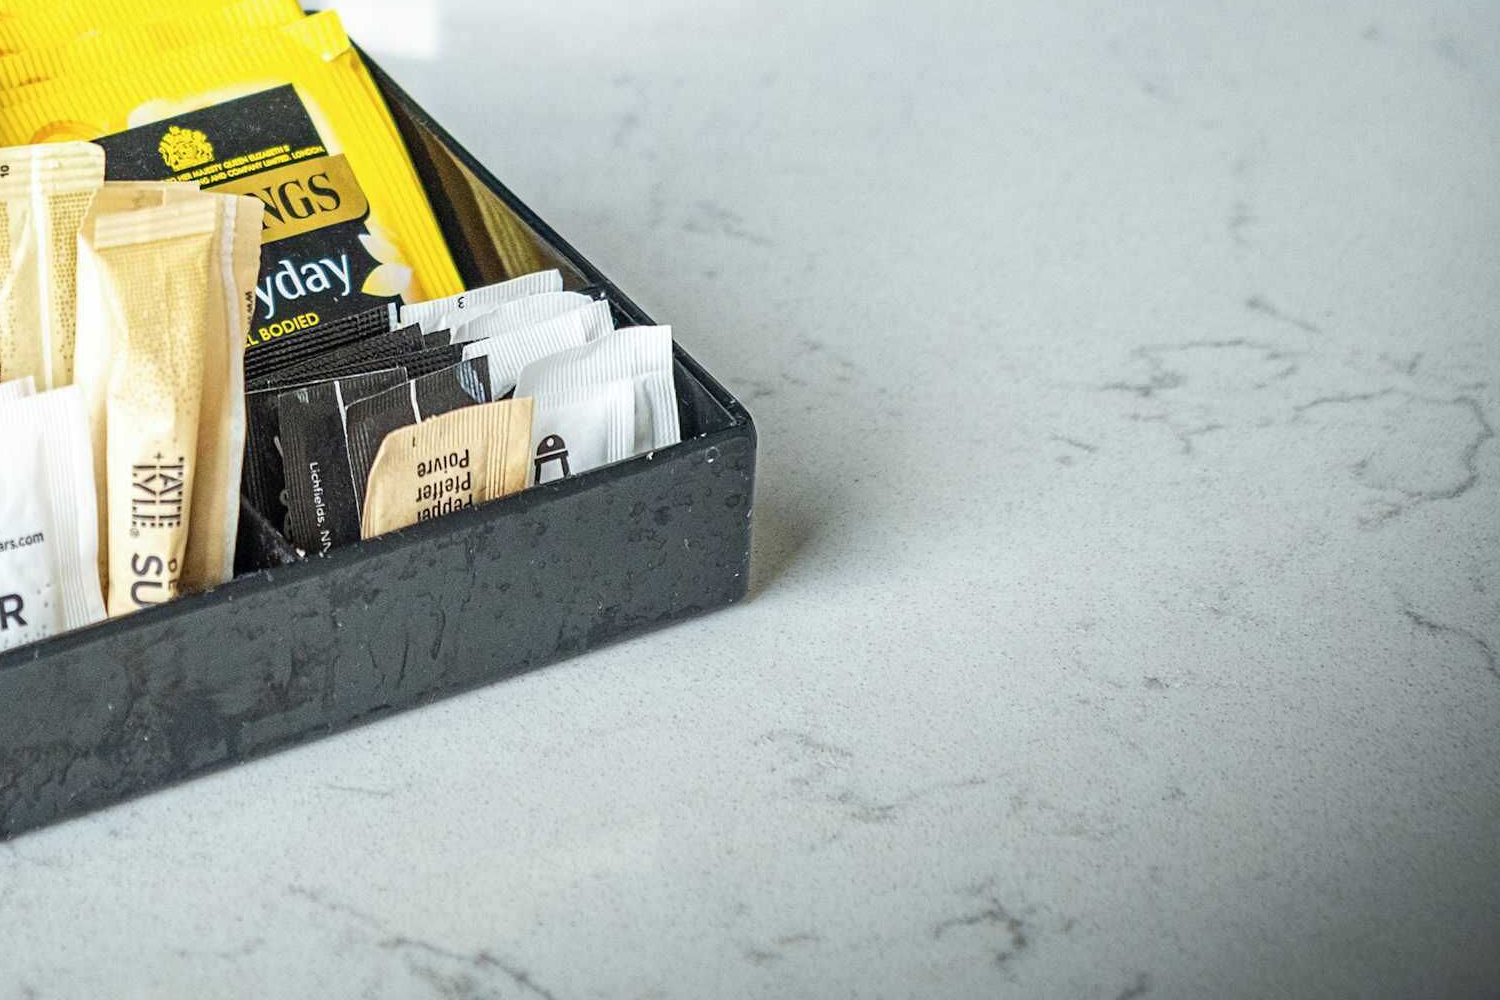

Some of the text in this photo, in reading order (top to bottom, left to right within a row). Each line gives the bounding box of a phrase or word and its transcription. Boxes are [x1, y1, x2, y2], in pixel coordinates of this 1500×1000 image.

[256, 254, 351, 320] yday
[457, 297, 465, 310] 3
[259, 312, 321, 342] BODIED
[417, 448, 469, 478] Poivre
[131, 465, 157, 528] LYLE
[159, 456, 185, 528] TATE
[309, 461, 327, 528] Lichfields,
[416, 472, 472, 502] Pfeffer
